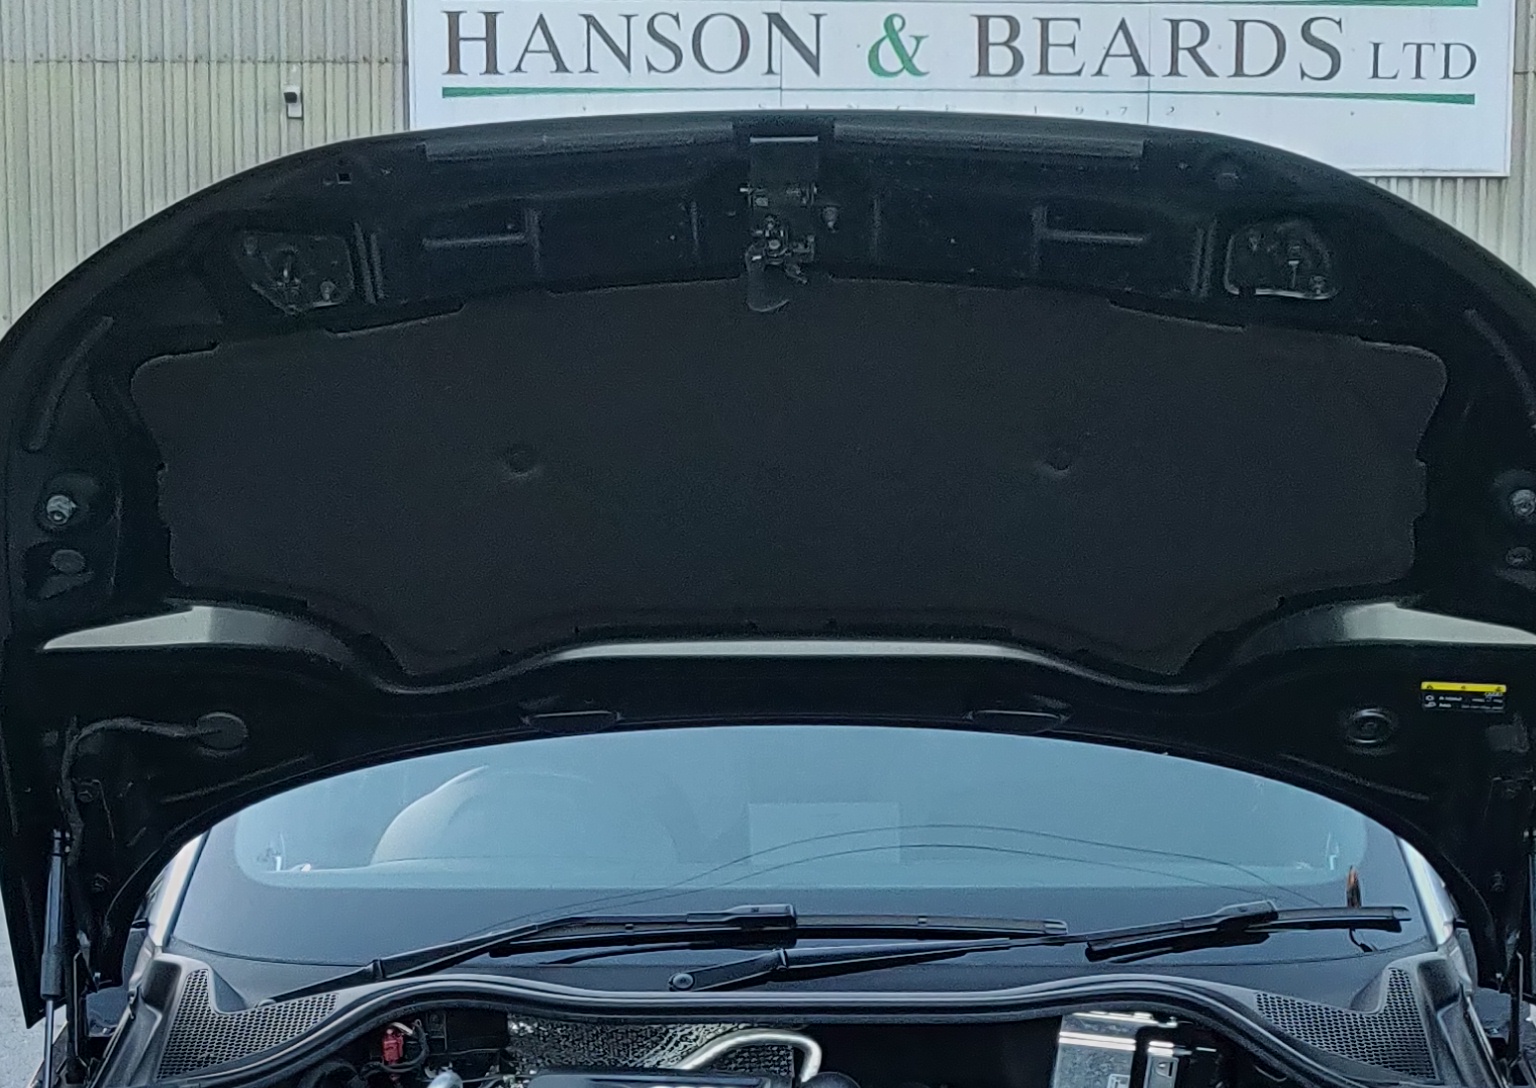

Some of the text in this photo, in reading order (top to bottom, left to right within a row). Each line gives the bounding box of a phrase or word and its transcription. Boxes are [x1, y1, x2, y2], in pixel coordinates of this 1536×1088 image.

[441, 9, 1478, 83] HANSON & BEARDS LTD
